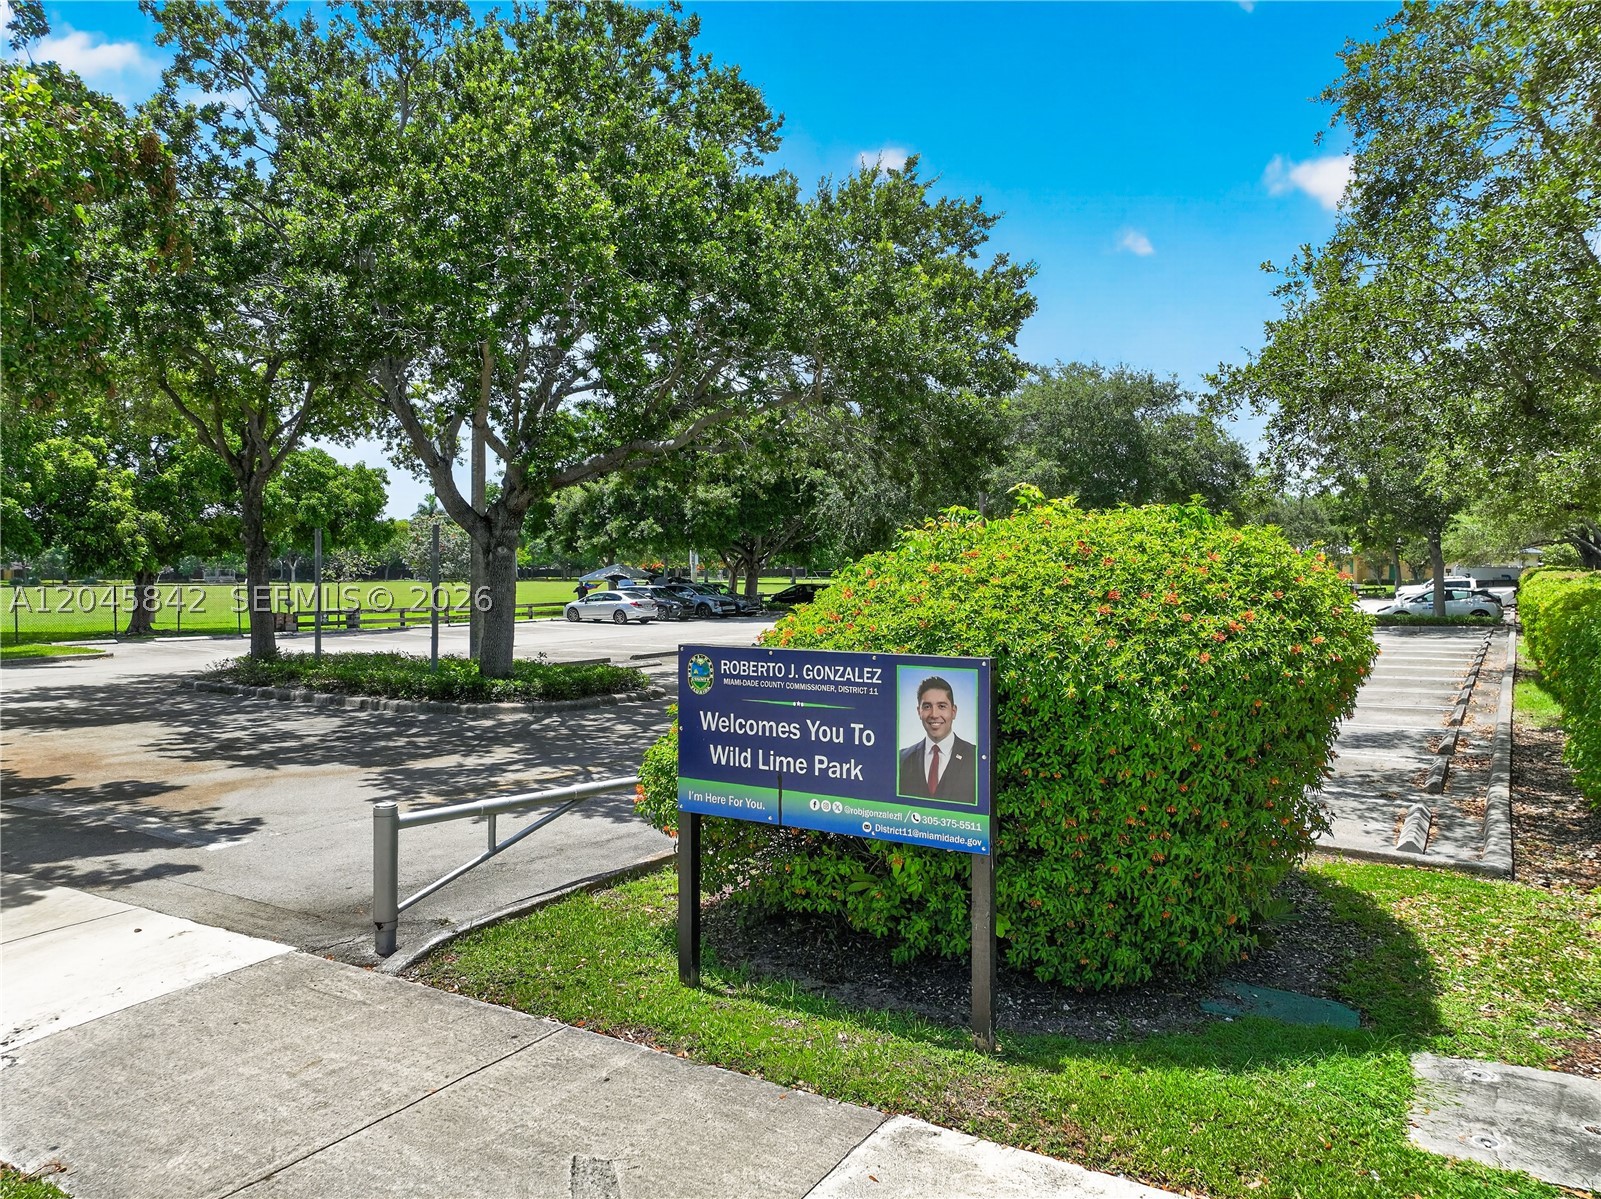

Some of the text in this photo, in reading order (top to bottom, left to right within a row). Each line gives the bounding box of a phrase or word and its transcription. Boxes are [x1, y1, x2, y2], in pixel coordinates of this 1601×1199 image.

[720, 660, 785, 677] ROBERTO
[788, 663, 799, 679] J.
[803, 664, 882, 684] GONZALEZ
[723, 677, 879, 695] MIAMI-DADE COUNTY COMMISSIONER, DISTRICT 11
[699, 710, 875, 746] Welcomes You To
[709, 744, 864, 781] Wild Lime Park
[705, 792, 726, 804] Here
[728, 795, 744, 807] For
[745, 797, 766, 810] You.
[875, 823, 982, 847] District11@miamidade.gov
[921, 815, 982, 832] 305-375-5511
